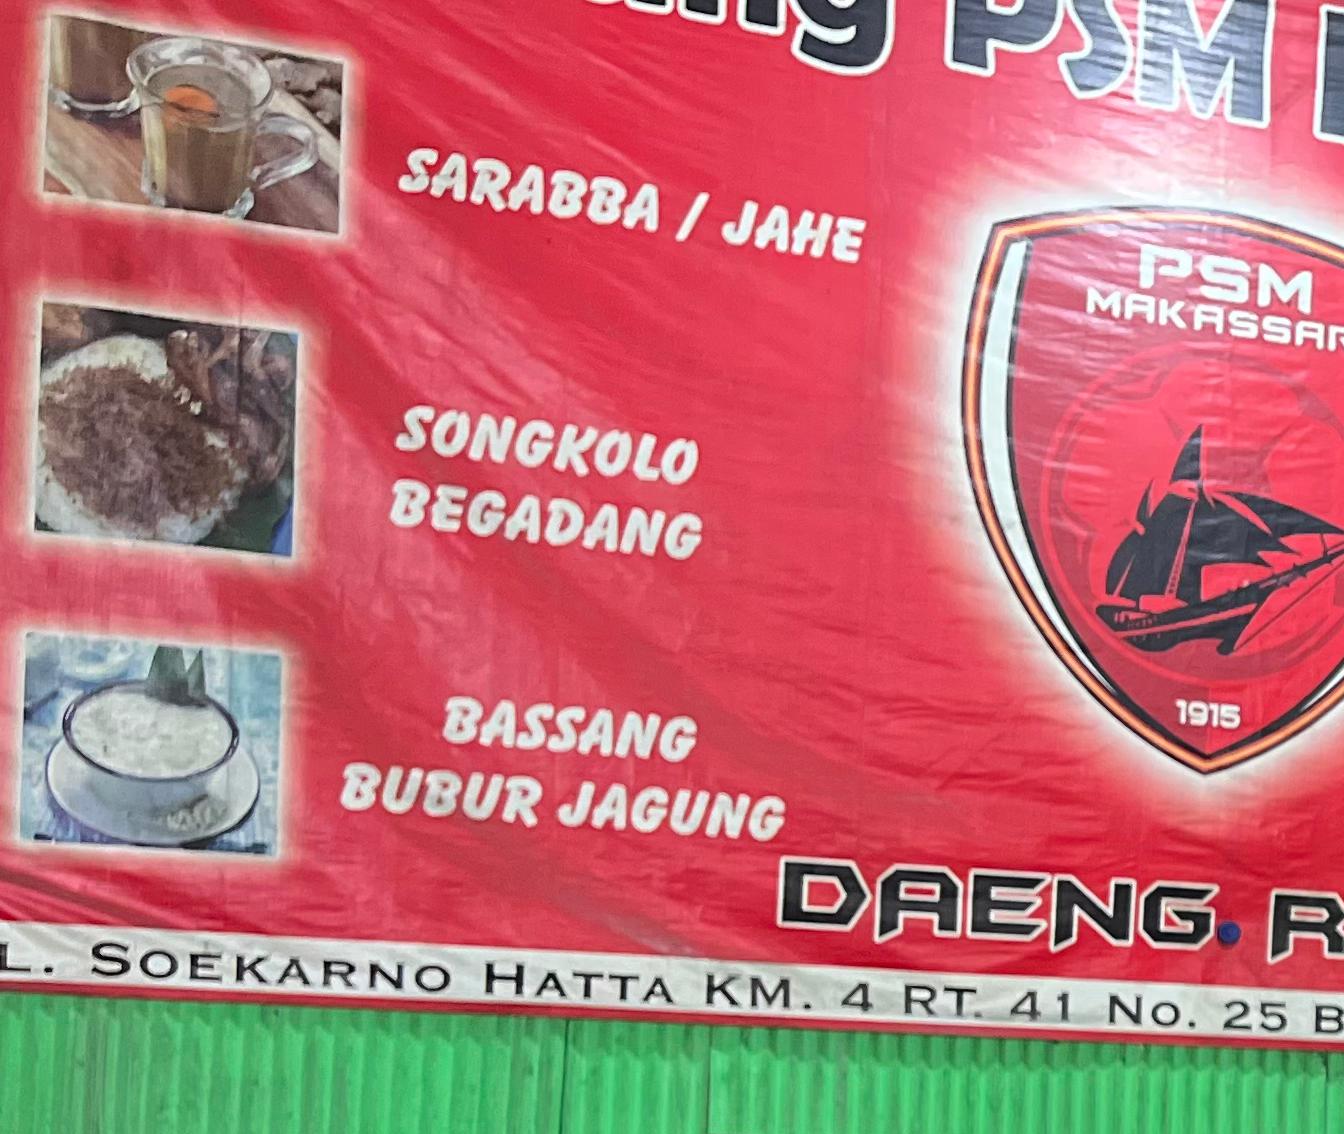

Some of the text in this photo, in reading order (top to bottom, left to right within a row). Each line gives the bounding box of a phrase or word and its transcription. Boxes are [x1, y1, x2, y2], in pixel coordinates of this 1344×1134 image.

[945, 0, 1274, 128] PSM
[399, 148, 867, 263] SARABBA / JAHE
[1137, 243, 1315, 314] PSM
[395, 405, 700, 486] SONGKOLO
[389, 480, 704, 560] BEGADANG
[443, 697, 697, 762] BASSANG
[1176, 698, 1242, 730] 1915
[340, 763, 786, 843] BUBUR JAGUNG
[777, 856, 1220, 951] DAENG
[91, 941, 451, 994] SOEKARNO
[485, 961, 673, 1006] HATTA
[704, 972, 813, 1012] KM.
[841, 982, 873, 1012] 4
[902, 985, 983, 1020] RT.
[1011, 990, 1070, 1023] 41
[1222, 1001, 1288, 1033] 25
